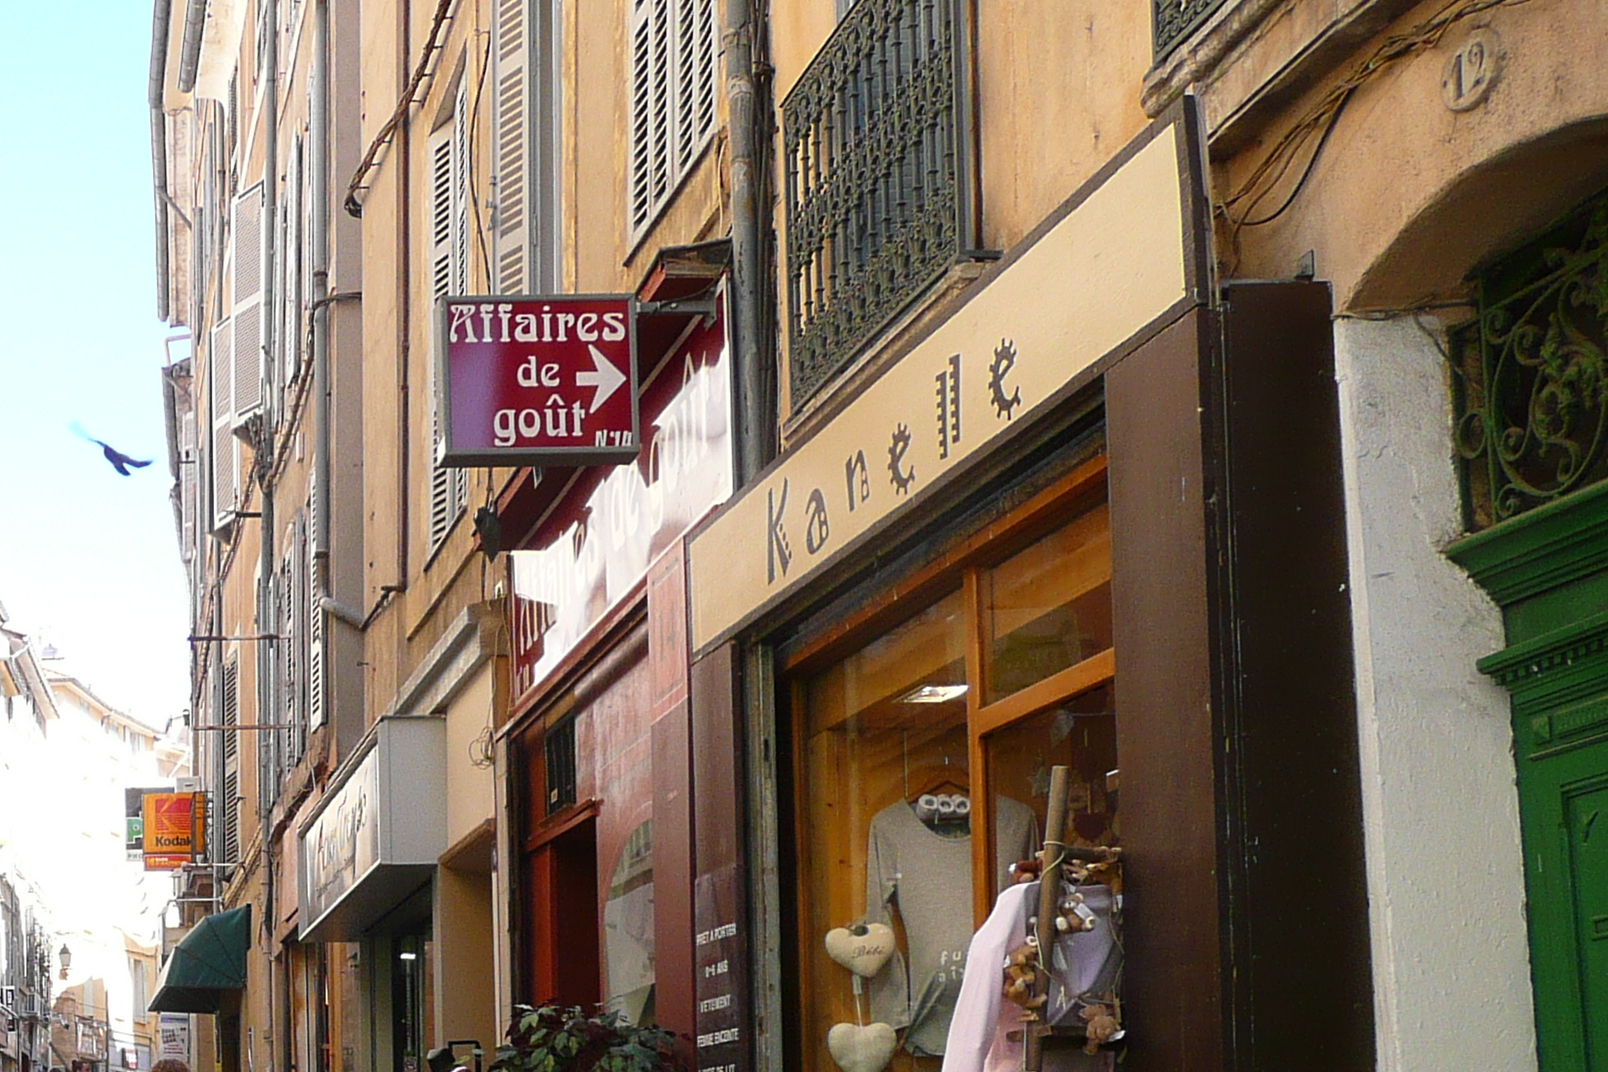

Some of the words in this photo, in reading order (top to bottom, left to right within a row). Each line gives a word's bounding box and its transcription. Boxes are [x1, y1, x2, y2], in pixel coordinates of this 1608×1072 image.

[1451, 40, 1487, 103] 12
[449, 303, 626, 343] Affaires
[517, 355, 560, 387] de
[493, 393, 585, 447] goût
[766, 336, 1022, 584] Kanelle
[155, 835, 192, 847] Kodak
[852, 944, 885, 959] Bébé
